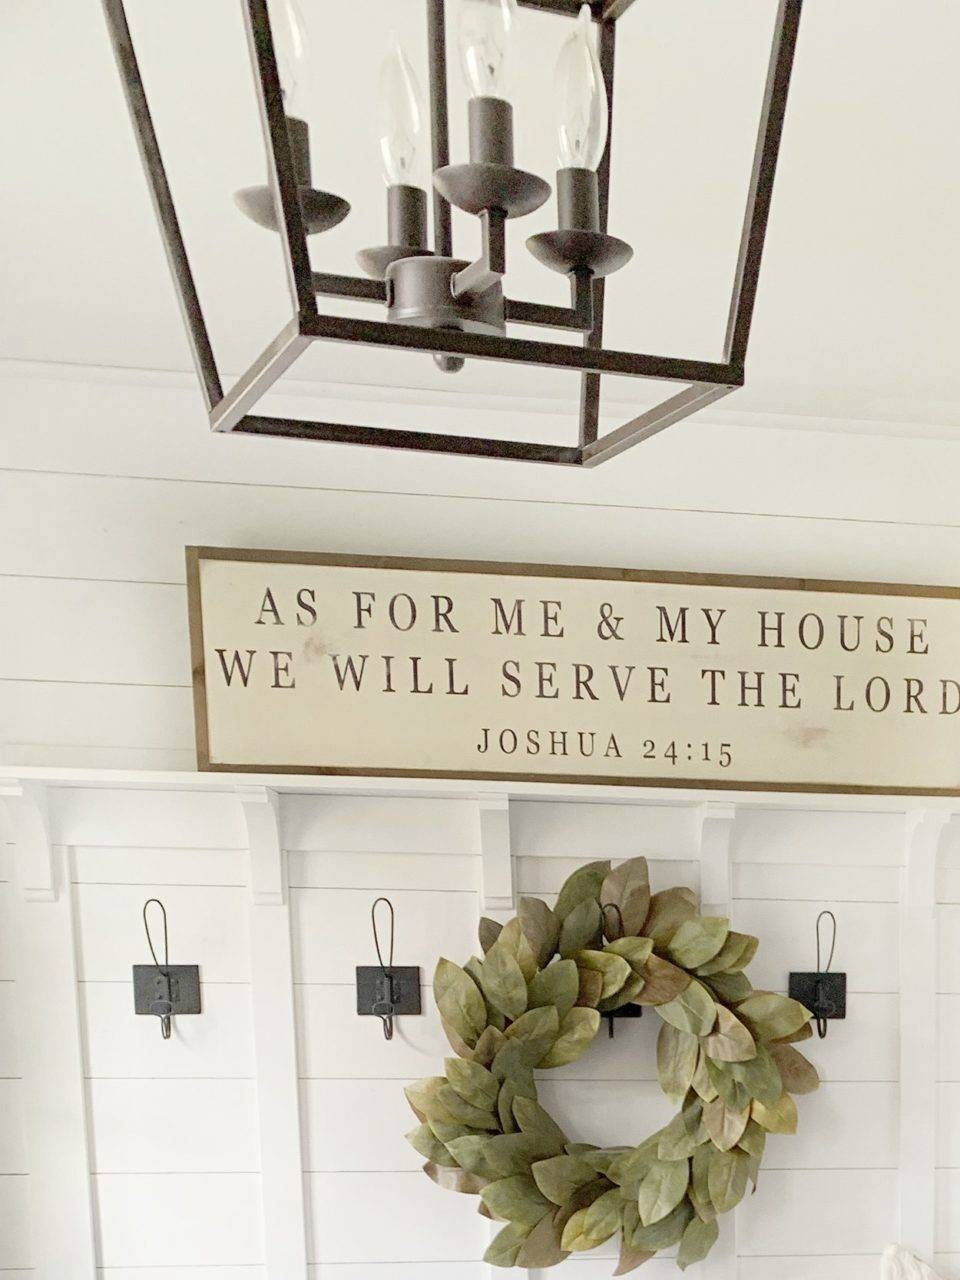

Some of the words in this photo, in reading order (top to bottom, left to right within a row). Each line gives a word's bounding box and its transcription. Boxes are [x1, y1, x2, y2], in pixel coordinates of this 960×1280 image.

[254, 587, 318, 627] AS
[352, 591, 459, 633] FOR
[490, 597, 565, 638] ME
[596, 602, 625, 641] &
[655, 605, 727, 645] MY
[757, 610, 930, 655] HOUSE
[214, 648, 296, 689] WE
[328, 653, 469, 696] WILL
[501, 659, 671, 703] SERVE
[701, 669, 802, 709] THE
[476, 727, 623, 759] JOSHUA
[642, 738, 733, 769] 24:15
